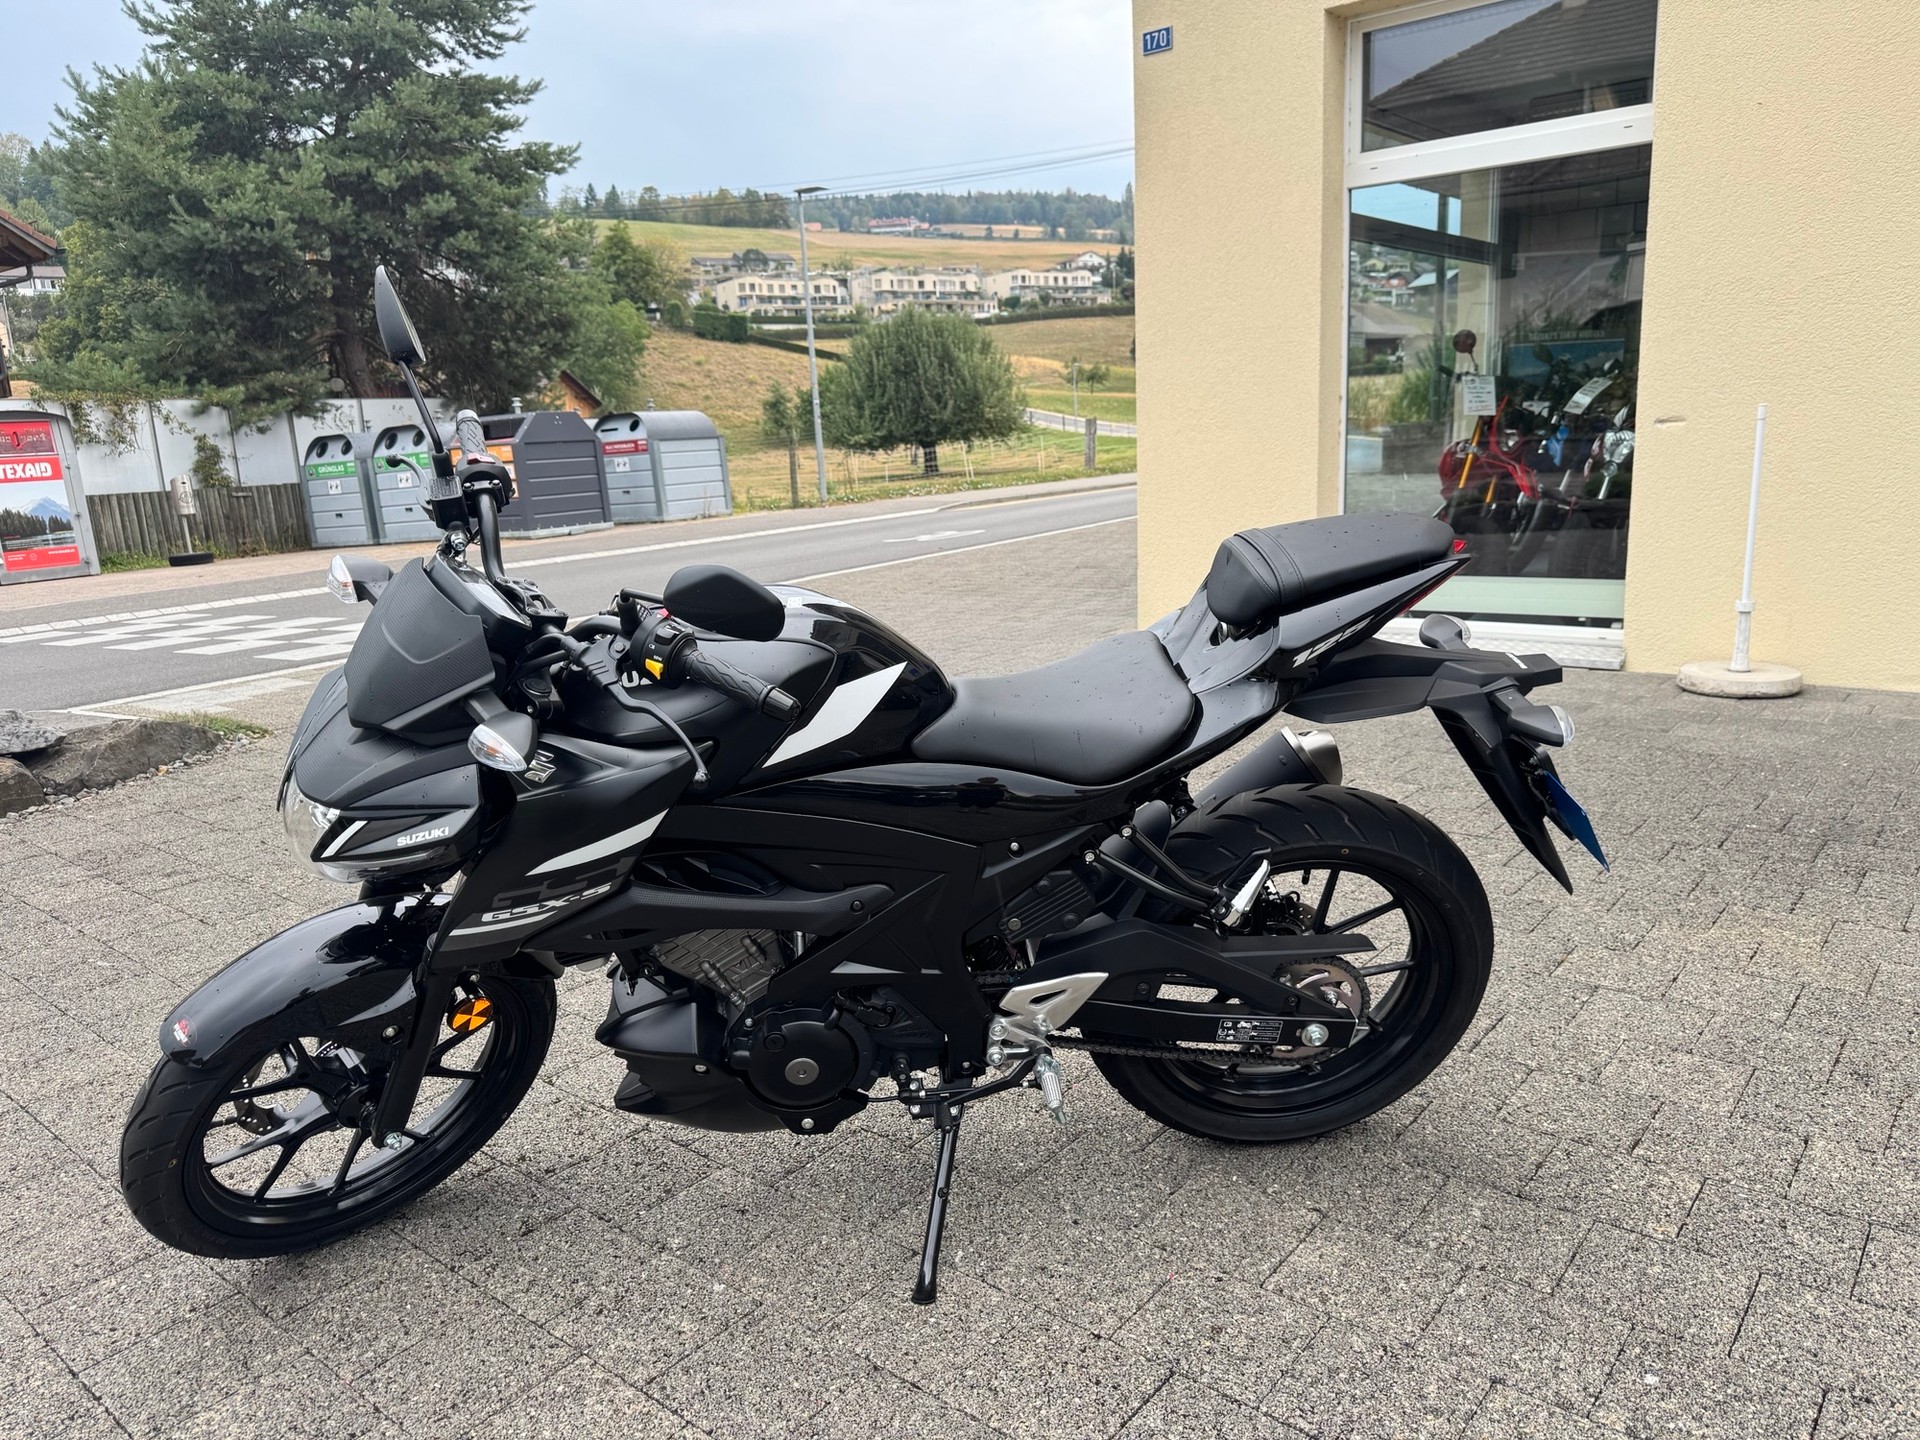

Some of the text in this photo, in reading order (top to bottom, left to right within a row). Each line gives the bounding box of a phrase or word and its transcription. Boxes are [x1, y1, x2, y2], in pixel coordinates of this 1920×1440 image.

[1145, 30, 1167, 50] 170
[0, 462, 52, 479] TEXAID
[1292, 614, 1376, 669] 125
[396, 826, 449, 847] SUZUKI
[481, 882, 612, 922] GSX-S
